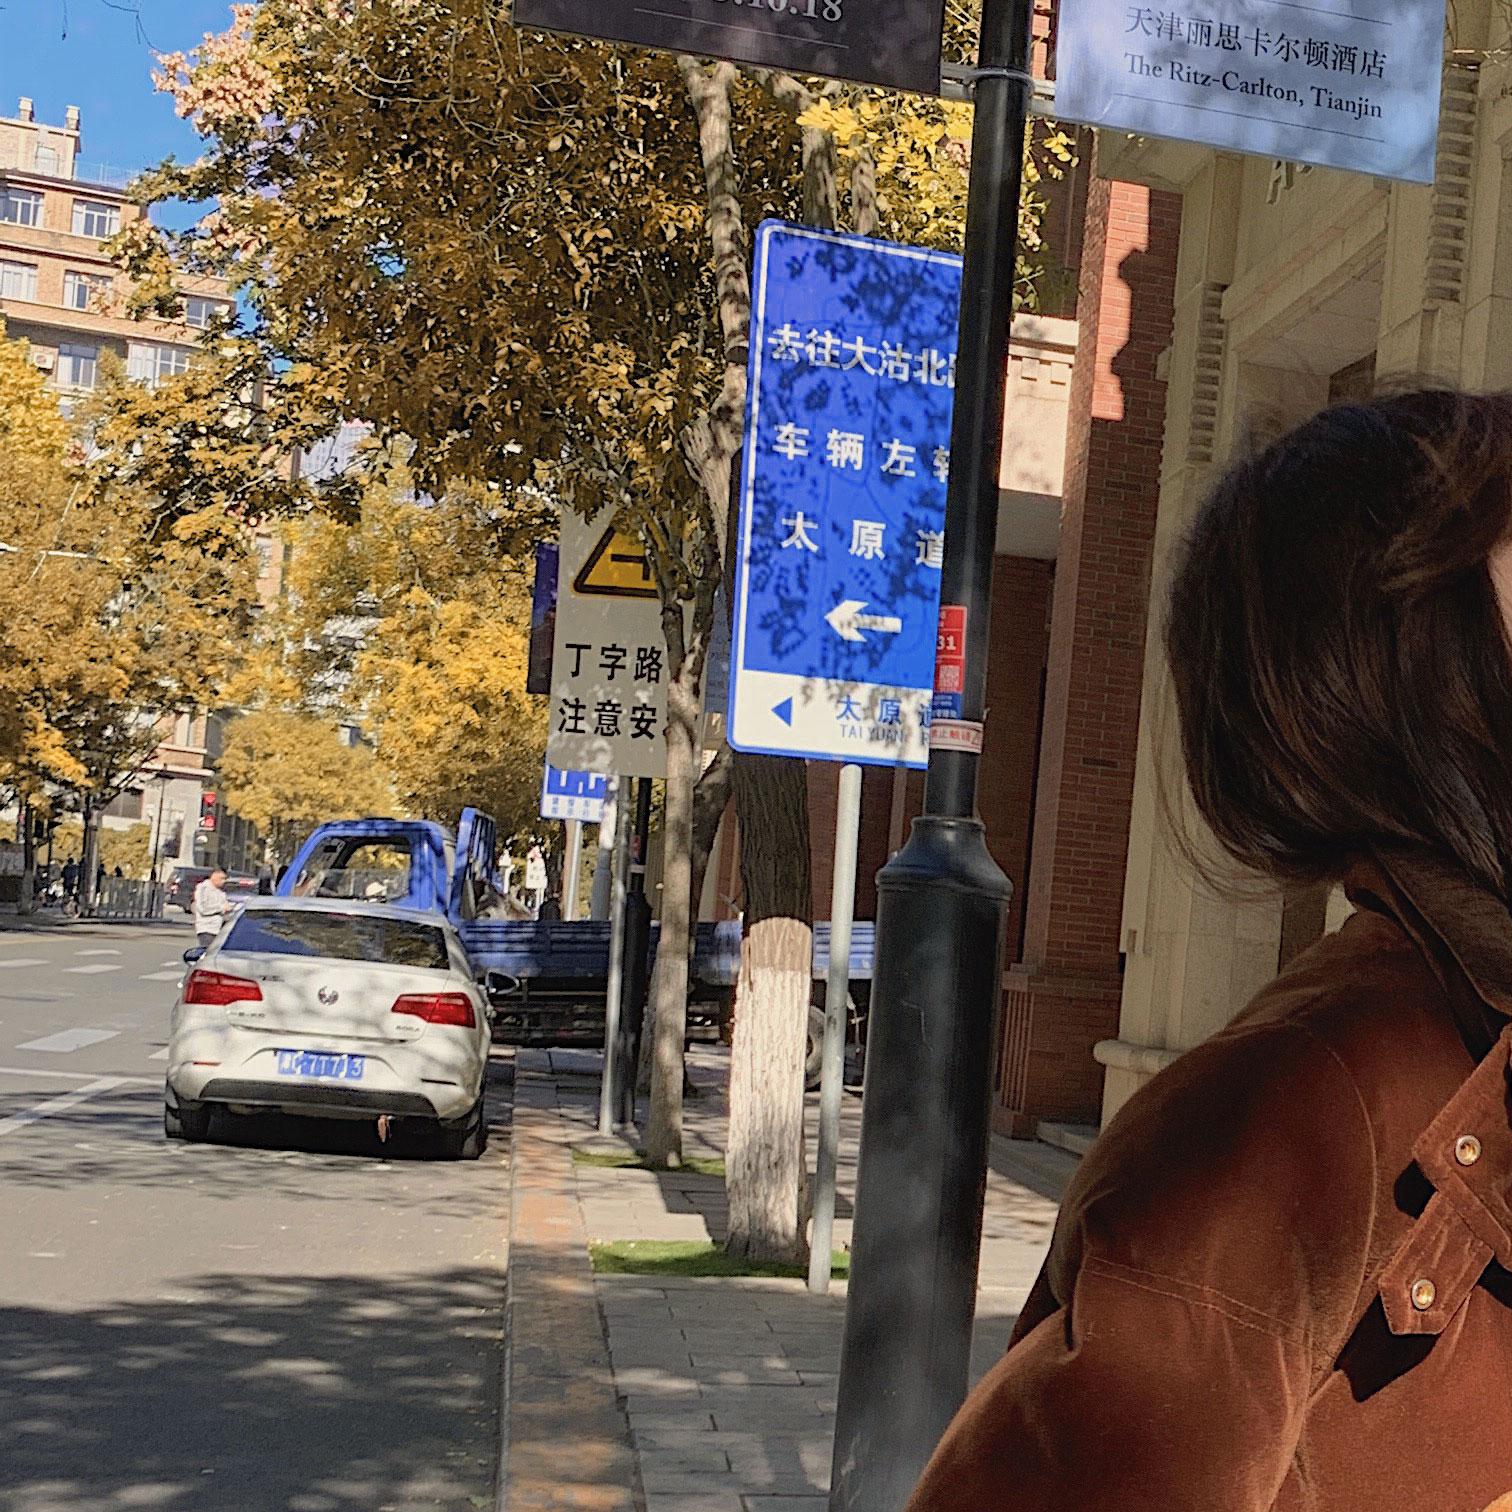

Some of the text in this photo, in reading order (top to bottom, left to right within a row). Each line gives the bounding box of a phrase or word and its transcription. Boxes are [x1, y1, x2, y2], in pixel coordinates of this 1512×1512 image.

[1125, 6, 1387, 80] 天津丽思卡尔顿酒店
[1124, 52, 1384, 121] The Ritz-Carlton, Tianjin
[768, 323, 957, 389] 去往大沽北
[781, 511, 945, 570] 太原道
[565, 643, 664, 684] 丁字路
[558, 697, 658, 740] 注意安
